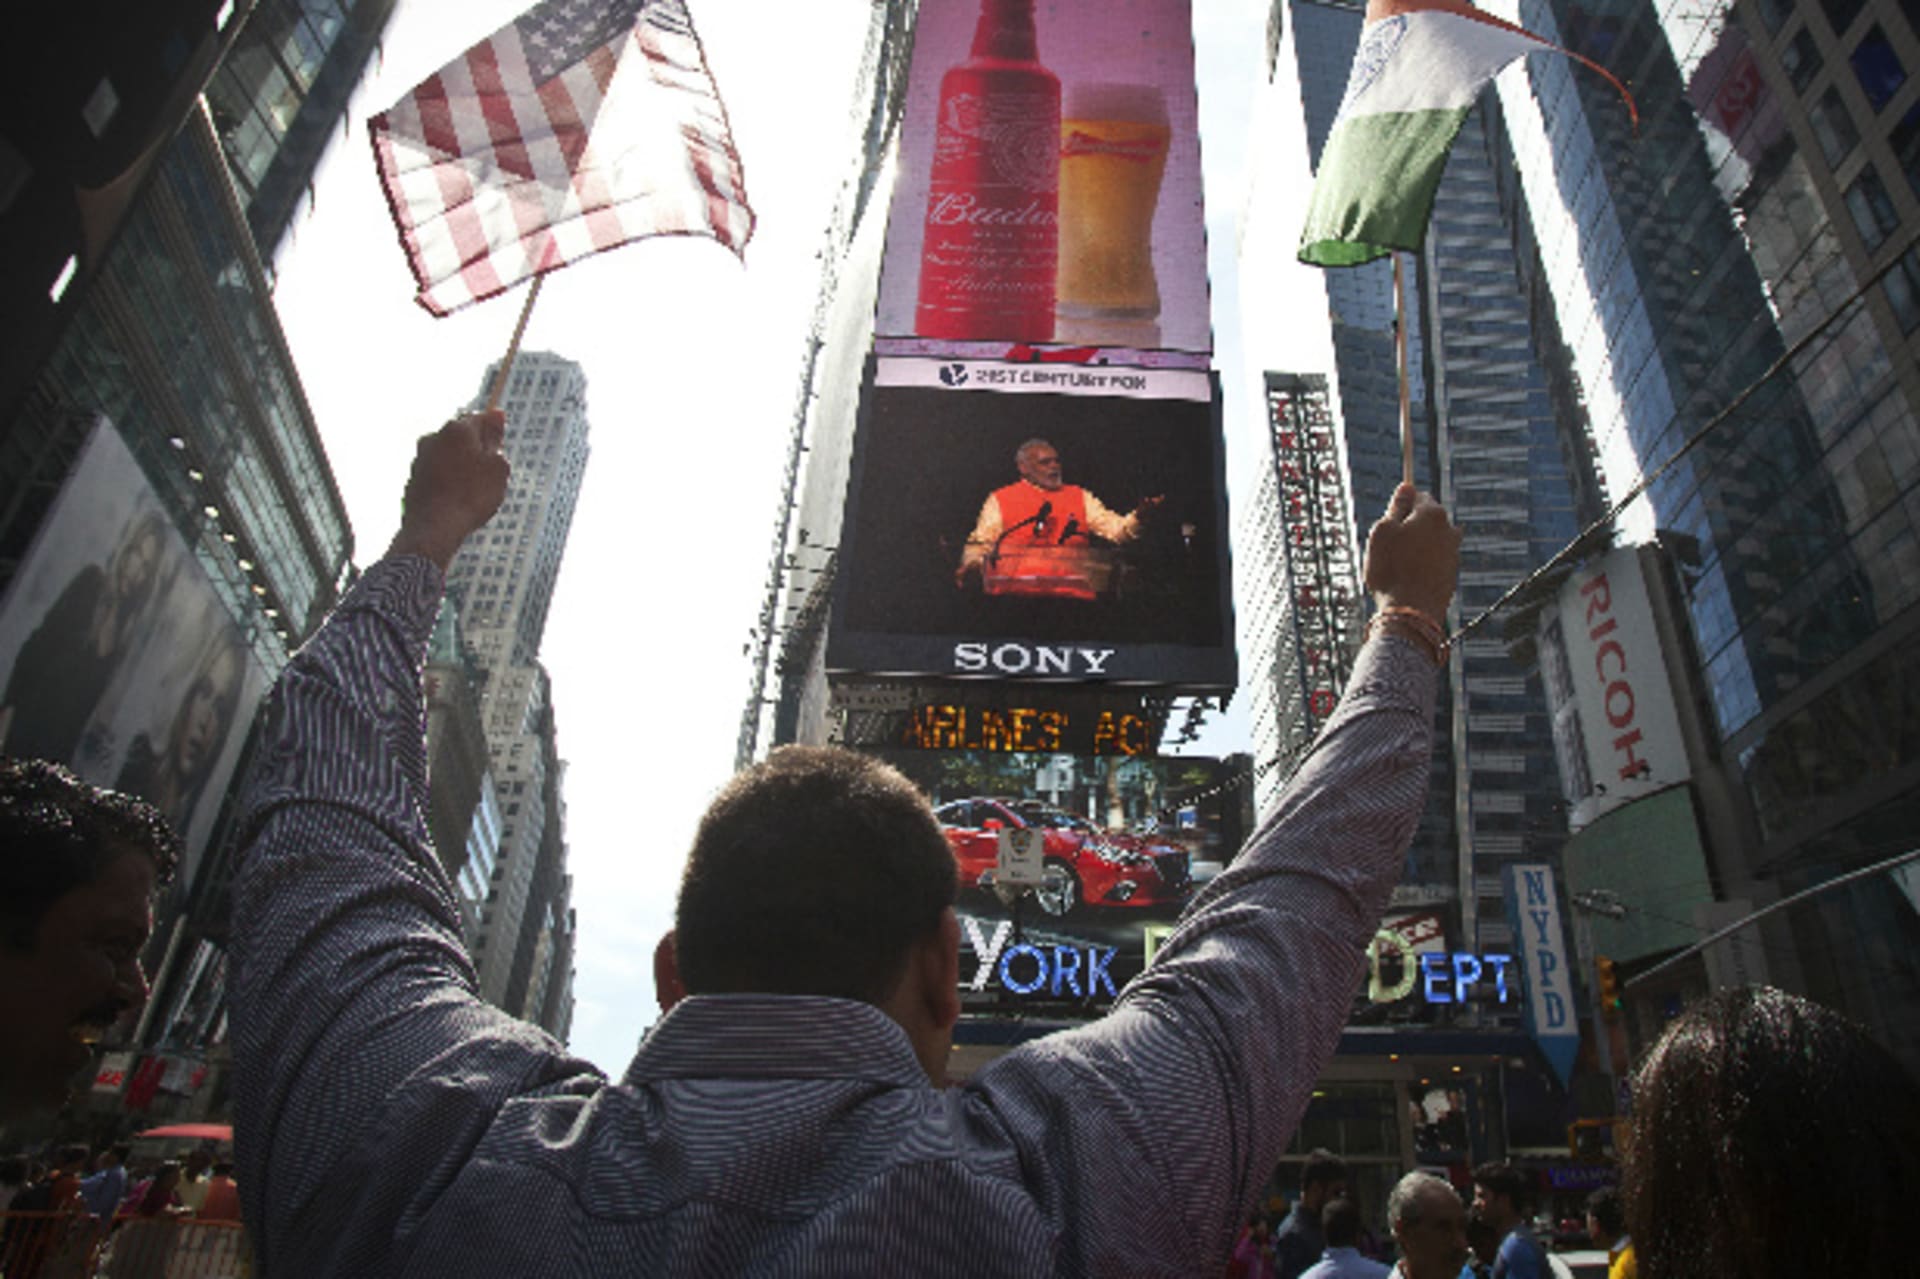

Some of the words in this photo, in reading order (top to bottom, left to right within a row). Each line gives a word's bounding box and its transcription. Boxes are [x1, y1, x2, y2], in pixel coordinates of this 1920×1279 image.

[1110, 375, 1147, 390] FOX
[953, 643, 1115, 673] SONY
[1580, 571, 1650, 782] RICOH
[963, 914, 1119, 997] YORK
[1366, 928, 1511, 1004] DEPT
[1523, 871, 1566, 1028] NYPD
